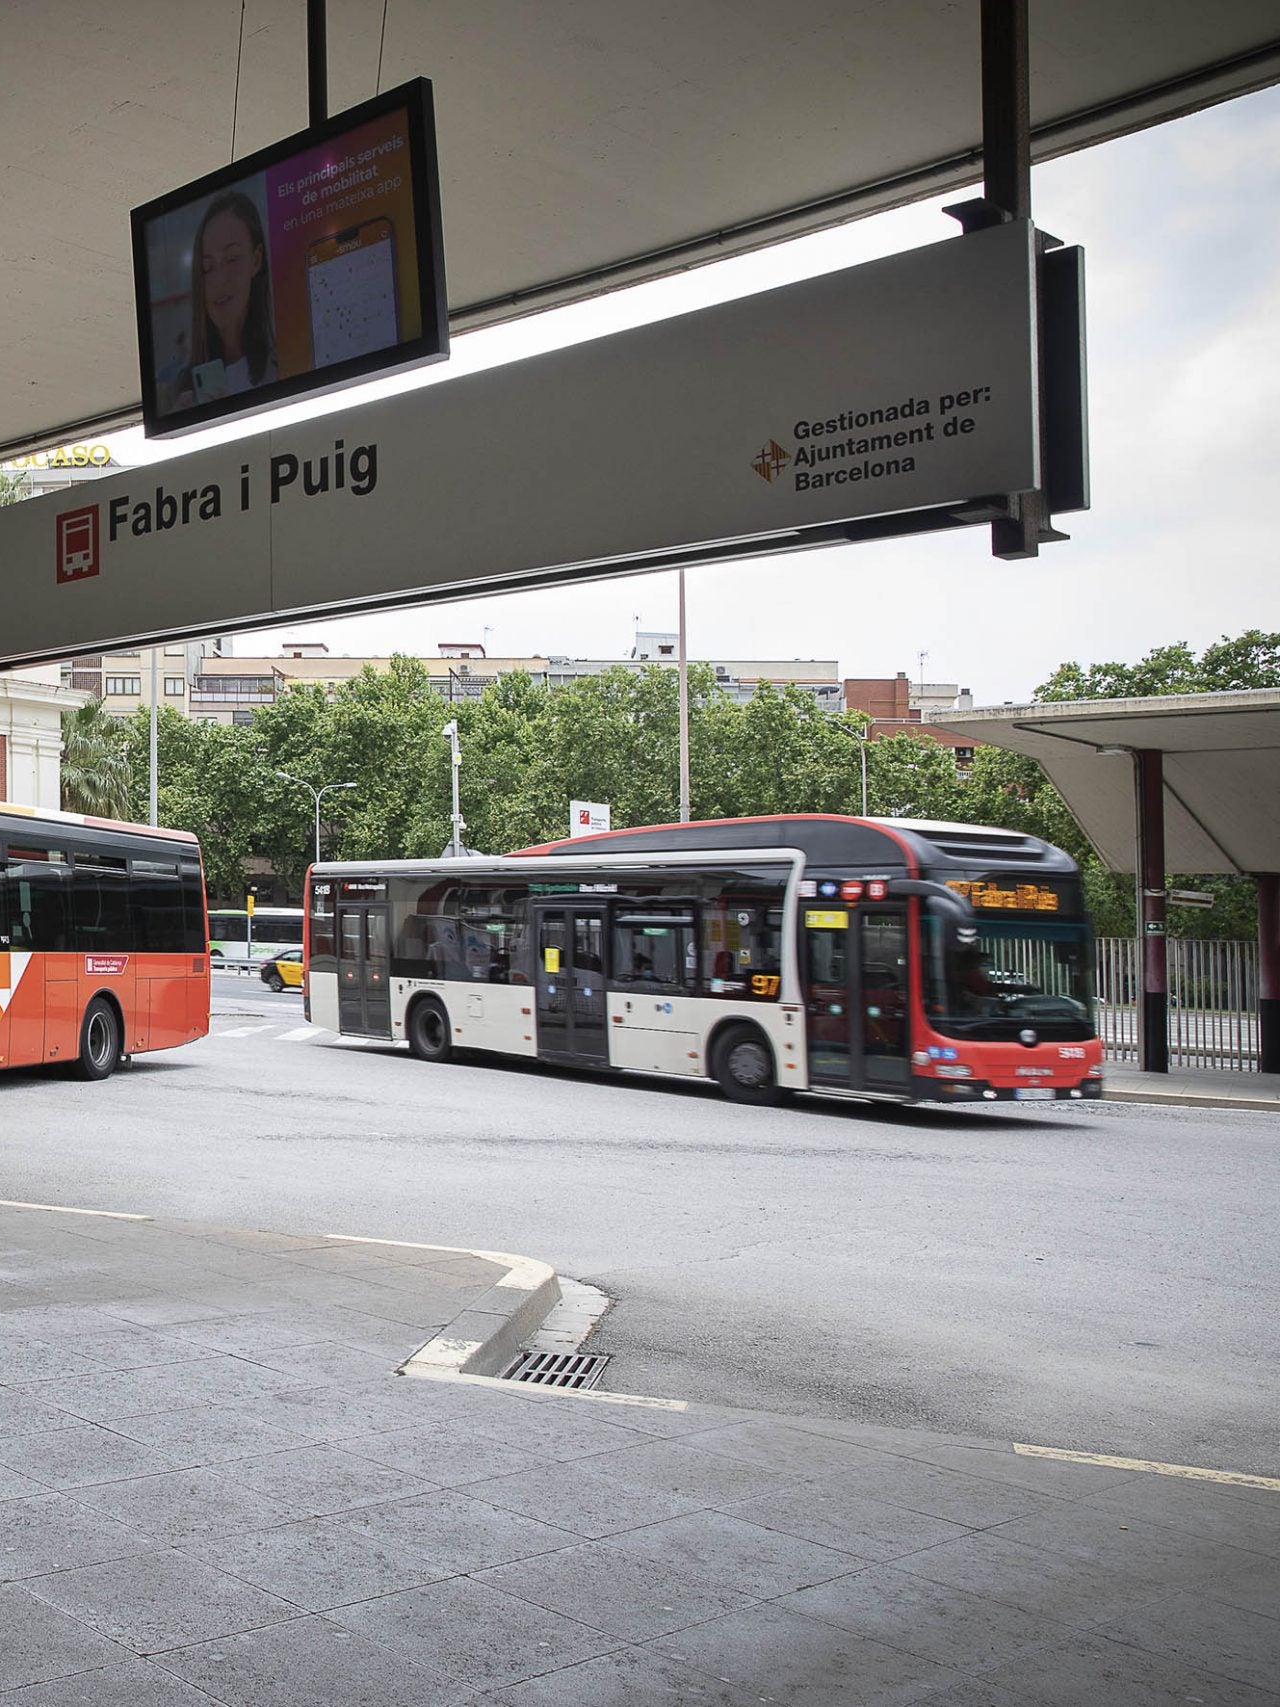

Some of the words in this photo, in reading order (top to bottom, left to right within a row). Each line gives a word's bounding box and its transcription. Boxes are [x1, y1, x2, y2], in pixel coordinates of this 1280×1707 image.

[277, 182, 296, 198] Els
[297, 156, 356, 193] principals
[357, 134, 404, 165] serveis
[302, 190, 318, 206] de
[320, 164, 379, 197] mobilitat
[283, 219, 298, 232] en
[300, 206, 323, 225] una
[326, 187, 375, 211] mateixa
[377, 175, 402, 195] app
[793, 397, 930, 440] Gestionada
[939, 385, 992, 415] per:
[793, 421, 935, 467] Ajuntament
[942, 415, 976, 438] de
[109, 483, 221, 542] Fabra
[240, 465, 250, 511] i
[270, 439, 378, 503] Puig
[795, 455, 916, 492] Barcelona
[751, 974, 782, 996] 97
